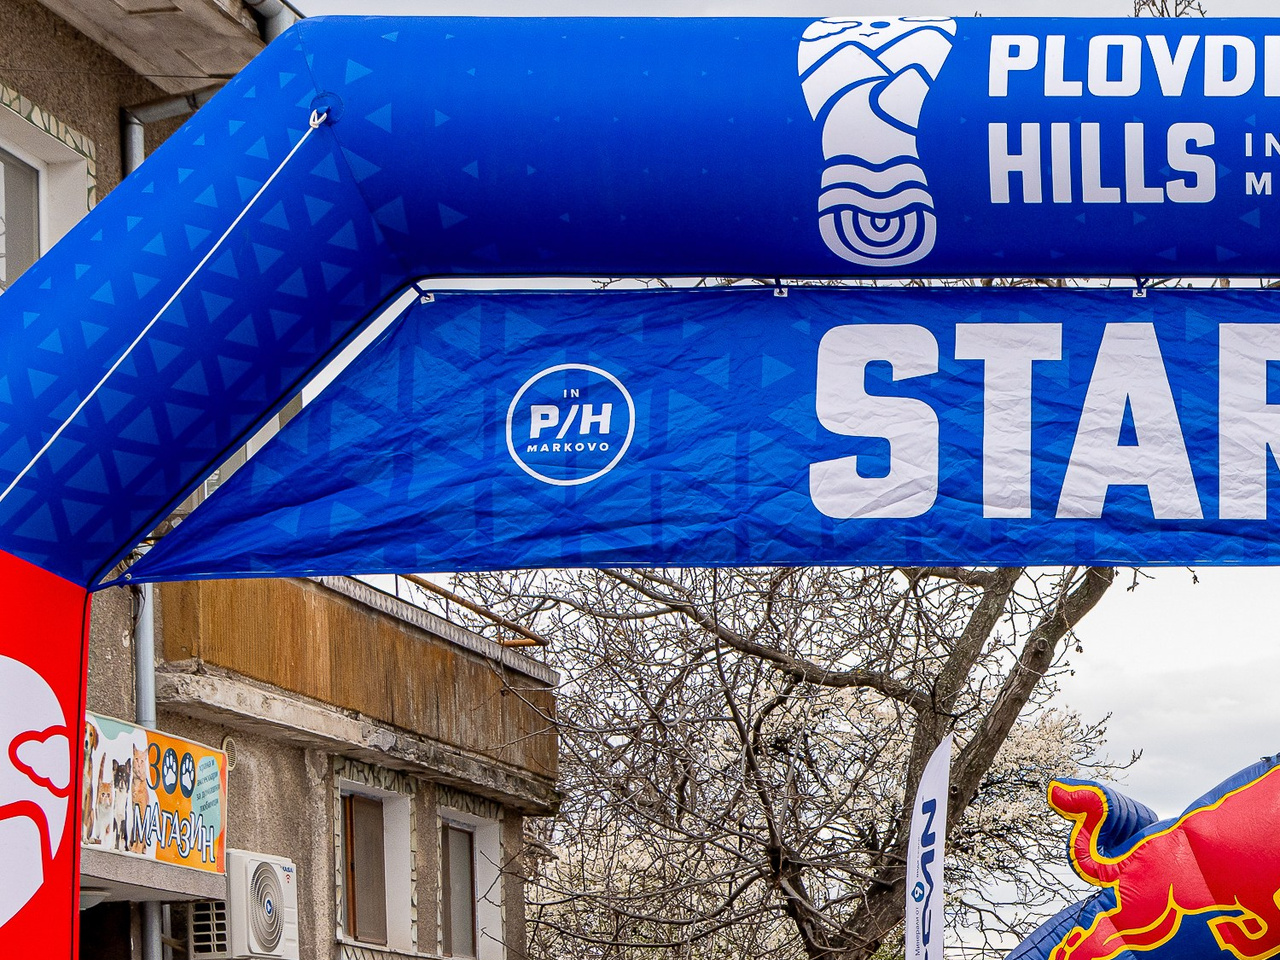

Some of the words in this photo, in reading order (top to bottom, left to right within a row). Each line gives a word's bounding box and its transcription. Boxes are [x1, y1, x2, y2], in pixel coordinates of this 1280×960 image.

[988, 122, 1216, 204] HILLS
[563, 388, 580, 399] IN
[529, 403, 613, 440] P/H
[526, 442, 610, 453] MARKOVO
[133, 802, 216, 863] МАГАЗИН
